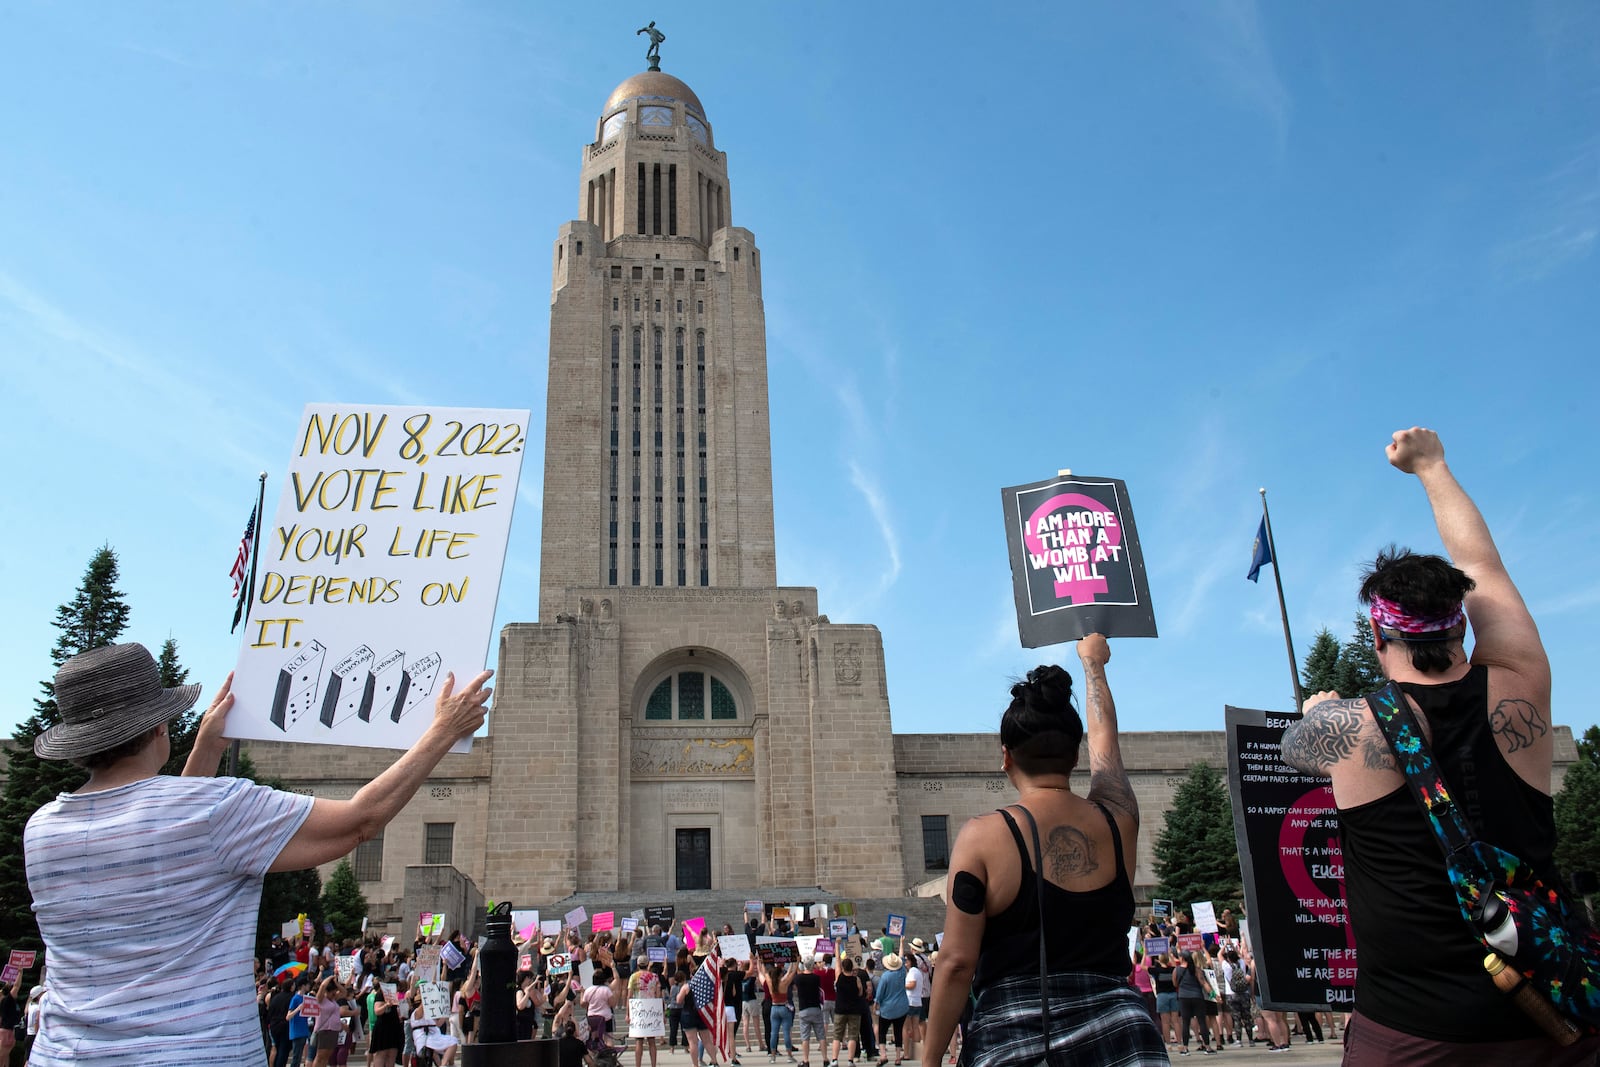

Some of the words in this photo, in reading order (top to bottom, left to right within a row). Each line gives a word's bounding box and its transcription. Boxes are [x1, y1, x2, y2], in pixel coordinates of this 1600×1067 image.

[299, 412, 388, 458] NOV
[291, 468, 407, 512] VOTE
[412, 471, 503, 514] LIKE
[1024, 520, 1031, 536] I
[1036, 513, 1064, 533] AM
[1066, 511, 1117, 528] MORE
[277, 523, 368, 565] YOUR
[388, 525, 480, 559] LIFE
[1036, 528, 1091, 550] THAN
[1095, 527, 1110, 545] A
[1028, 546, 1089, 570] WOMB
[1094, 545, 1122, 562] AT
[1052, 563, 1105, 584] WILL
[259, 571, 402, 605] DEPENDS
[420, 575, 470, 606] ON
[250, 617, 304, 649] IT.
[287, 654, 308, 672] ROE
[311, 643, 320, 652] V
[1253, 742, 1258, 750] A
[1240, 752, 1262, 760] OCCURS
[1242, 774, 1268, 782] CERTAIN
[1270, 775, 1288, 783] PARTS
[1247, 806, 1256, 814] SO
[1264, 807, 1287, 815] RAPIST
[1291, 819, 1308, 828] AND
[1310, 820, 1322, 828] WE
[1280, 847, 1310, 856] THAT'S
[1312, 847, 1319, 856] A
[1312, 864, 1344, 878] FUCK
[1297, 898, 1314, 908] THE
[1316, 898, 1348, 908] MAJOR
[1295, 914, 1317, 923] WILL
[1318, 914, 1348, 924] NEVER
[1304, 948, 1319, 959] WE
[1321, 949, 1342, 960] THE
[1296, 967, 1312, 978] WE
[1314, 968, 1335, 980] ARE
